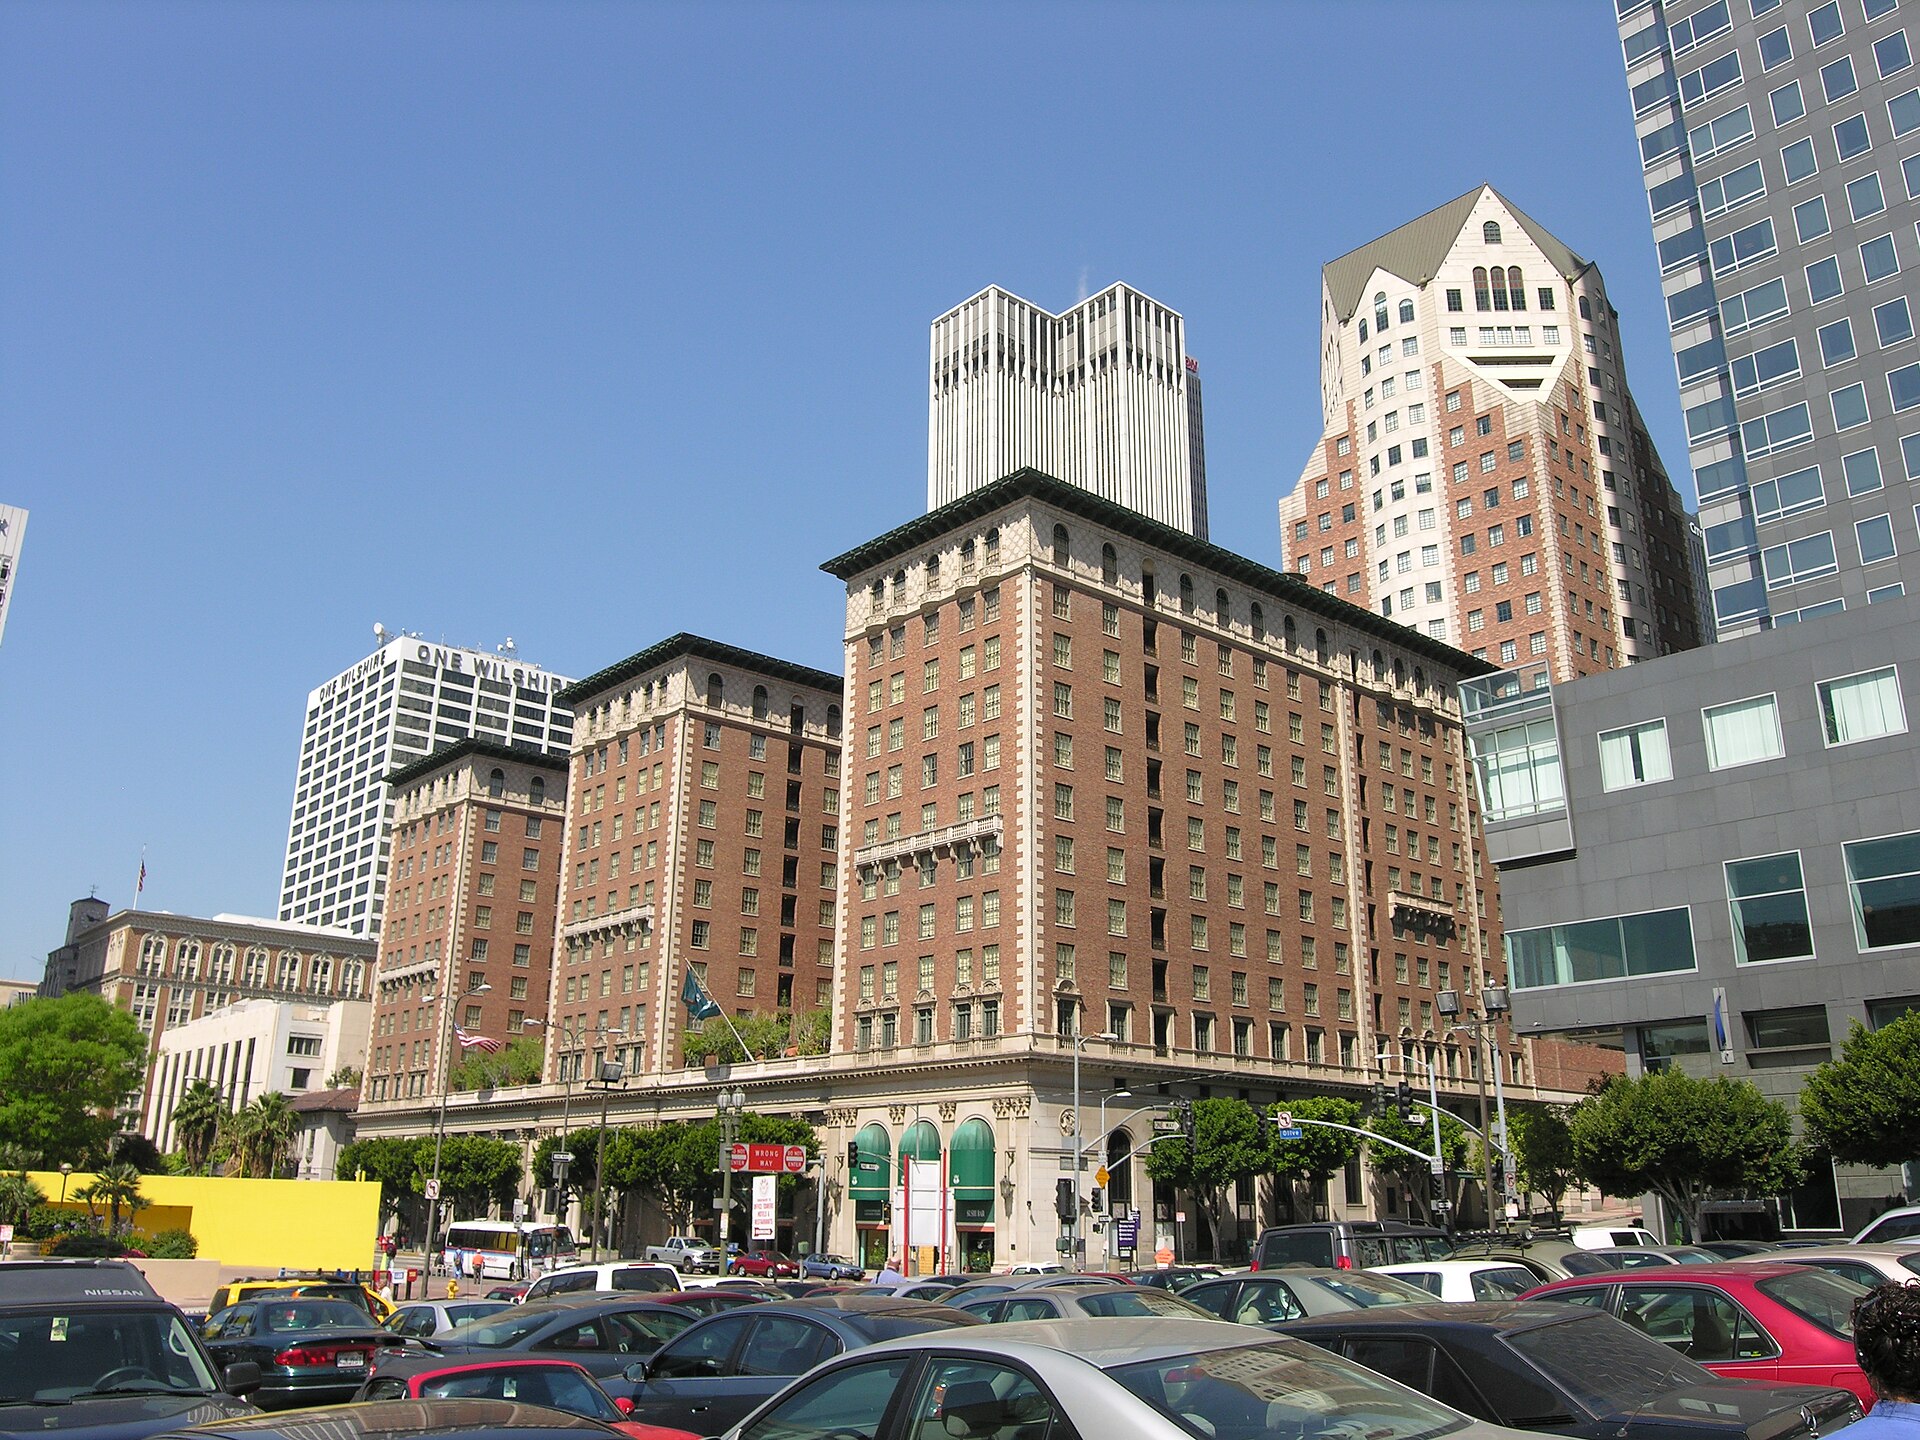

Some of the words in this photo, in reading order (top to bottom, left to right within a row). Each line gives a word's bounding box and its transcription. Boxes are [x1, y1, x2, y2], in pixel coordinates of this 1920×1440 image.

[319, 680, 338, 702] ONE
[341, 649, 387, 689] WILSHIRE
[418, 645, 463, 673] ONE
